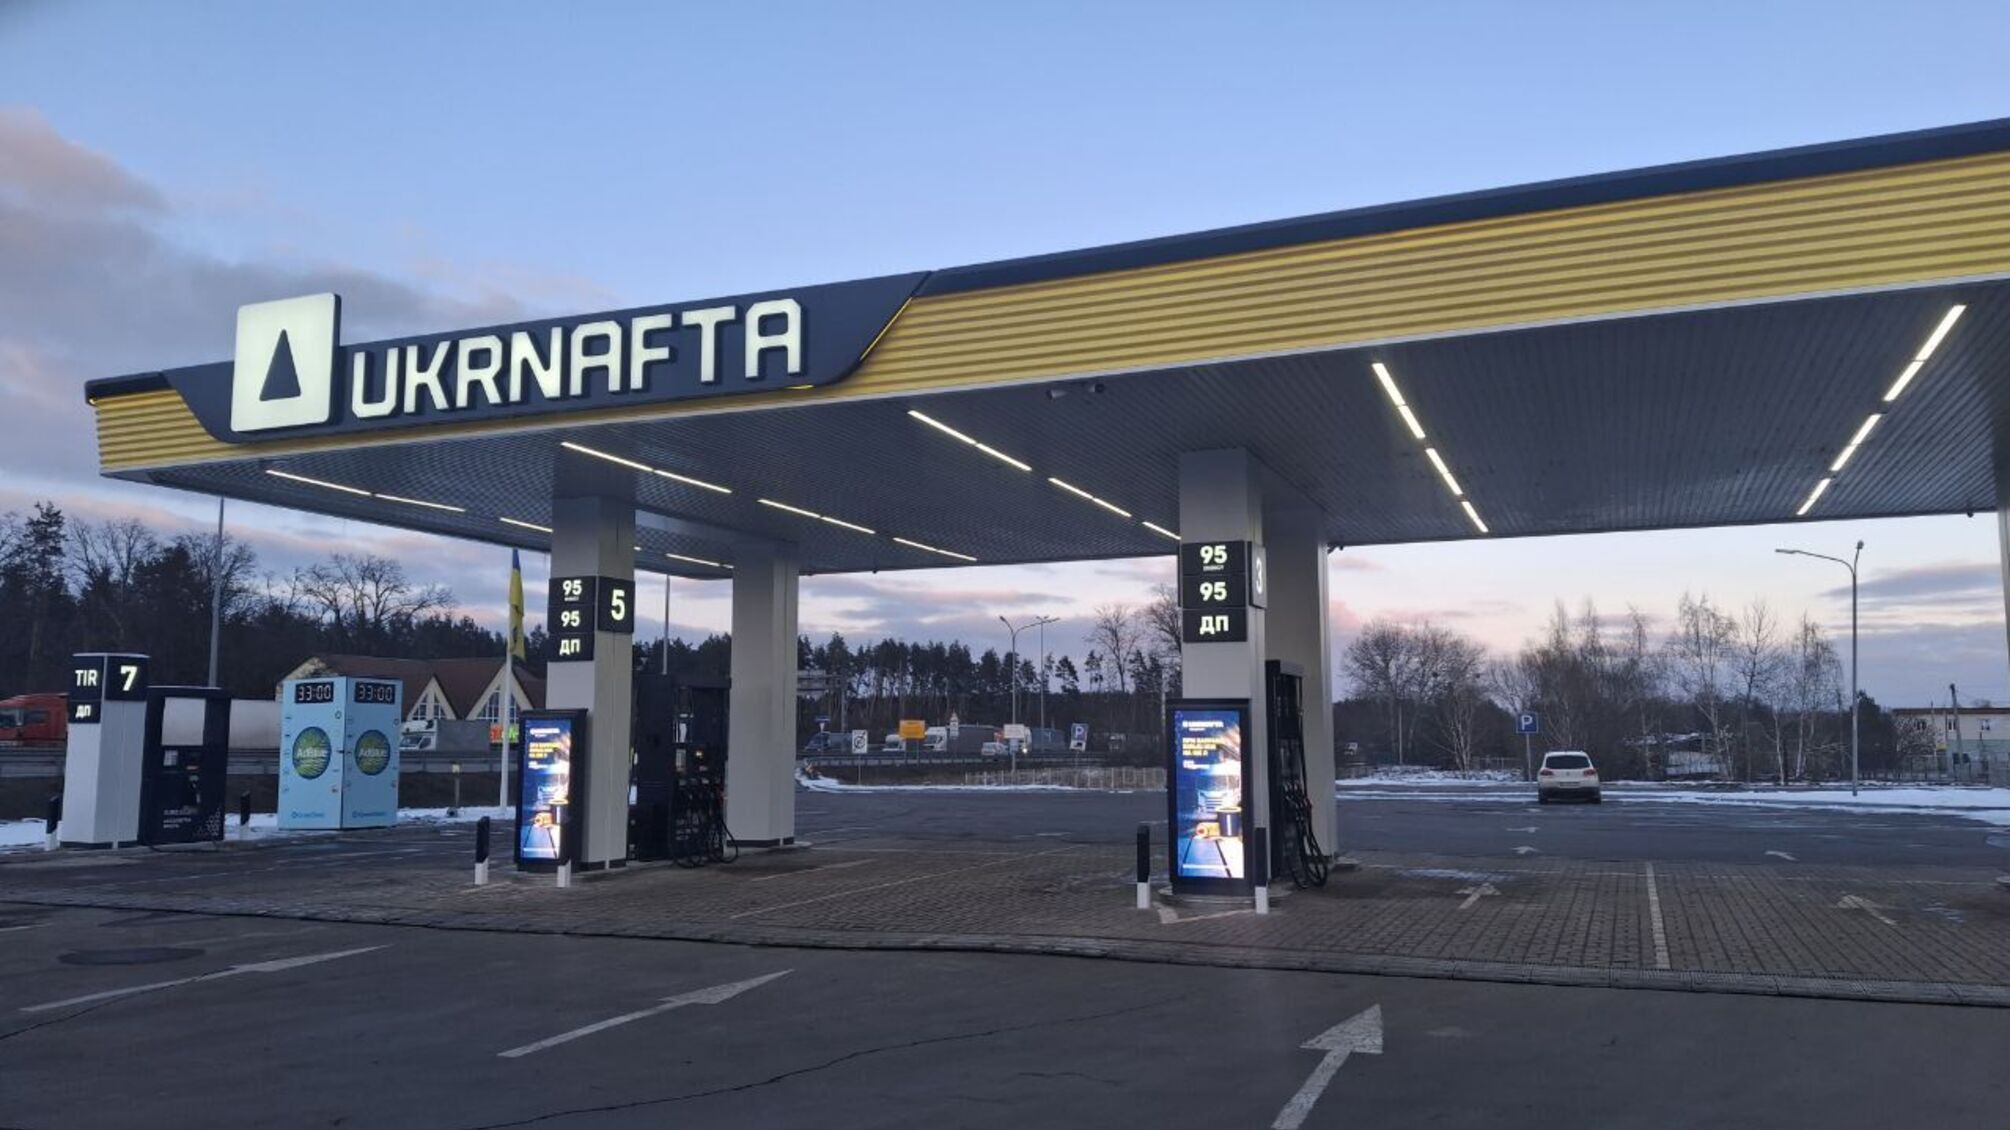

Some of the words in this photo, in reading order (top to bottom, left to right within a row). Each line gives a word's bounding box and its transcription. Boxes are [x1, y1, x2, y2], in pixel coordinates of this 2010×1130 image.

[351, 298, 802, 419] UKRNAFTA
[1200, 545, 1228, 564] 95
[1255, 556, 1263, 595] 3
[562, 579, 582, 596] 95
[1199, 581, 1227, 601] 95
[611, 588, 626, 621] 5
[561, 610, 581, 627] 95
[1199, 615, 1229, 635] ДП
[559, 639, 581, 656] ДП
[75, 669, 98, 687] TIR
[120, 665, 138, 692] 7
[75, 704, 92, 719] ДП
[1521, 715, 1533, 731] P
[1075, 726, 1085, 739] P
